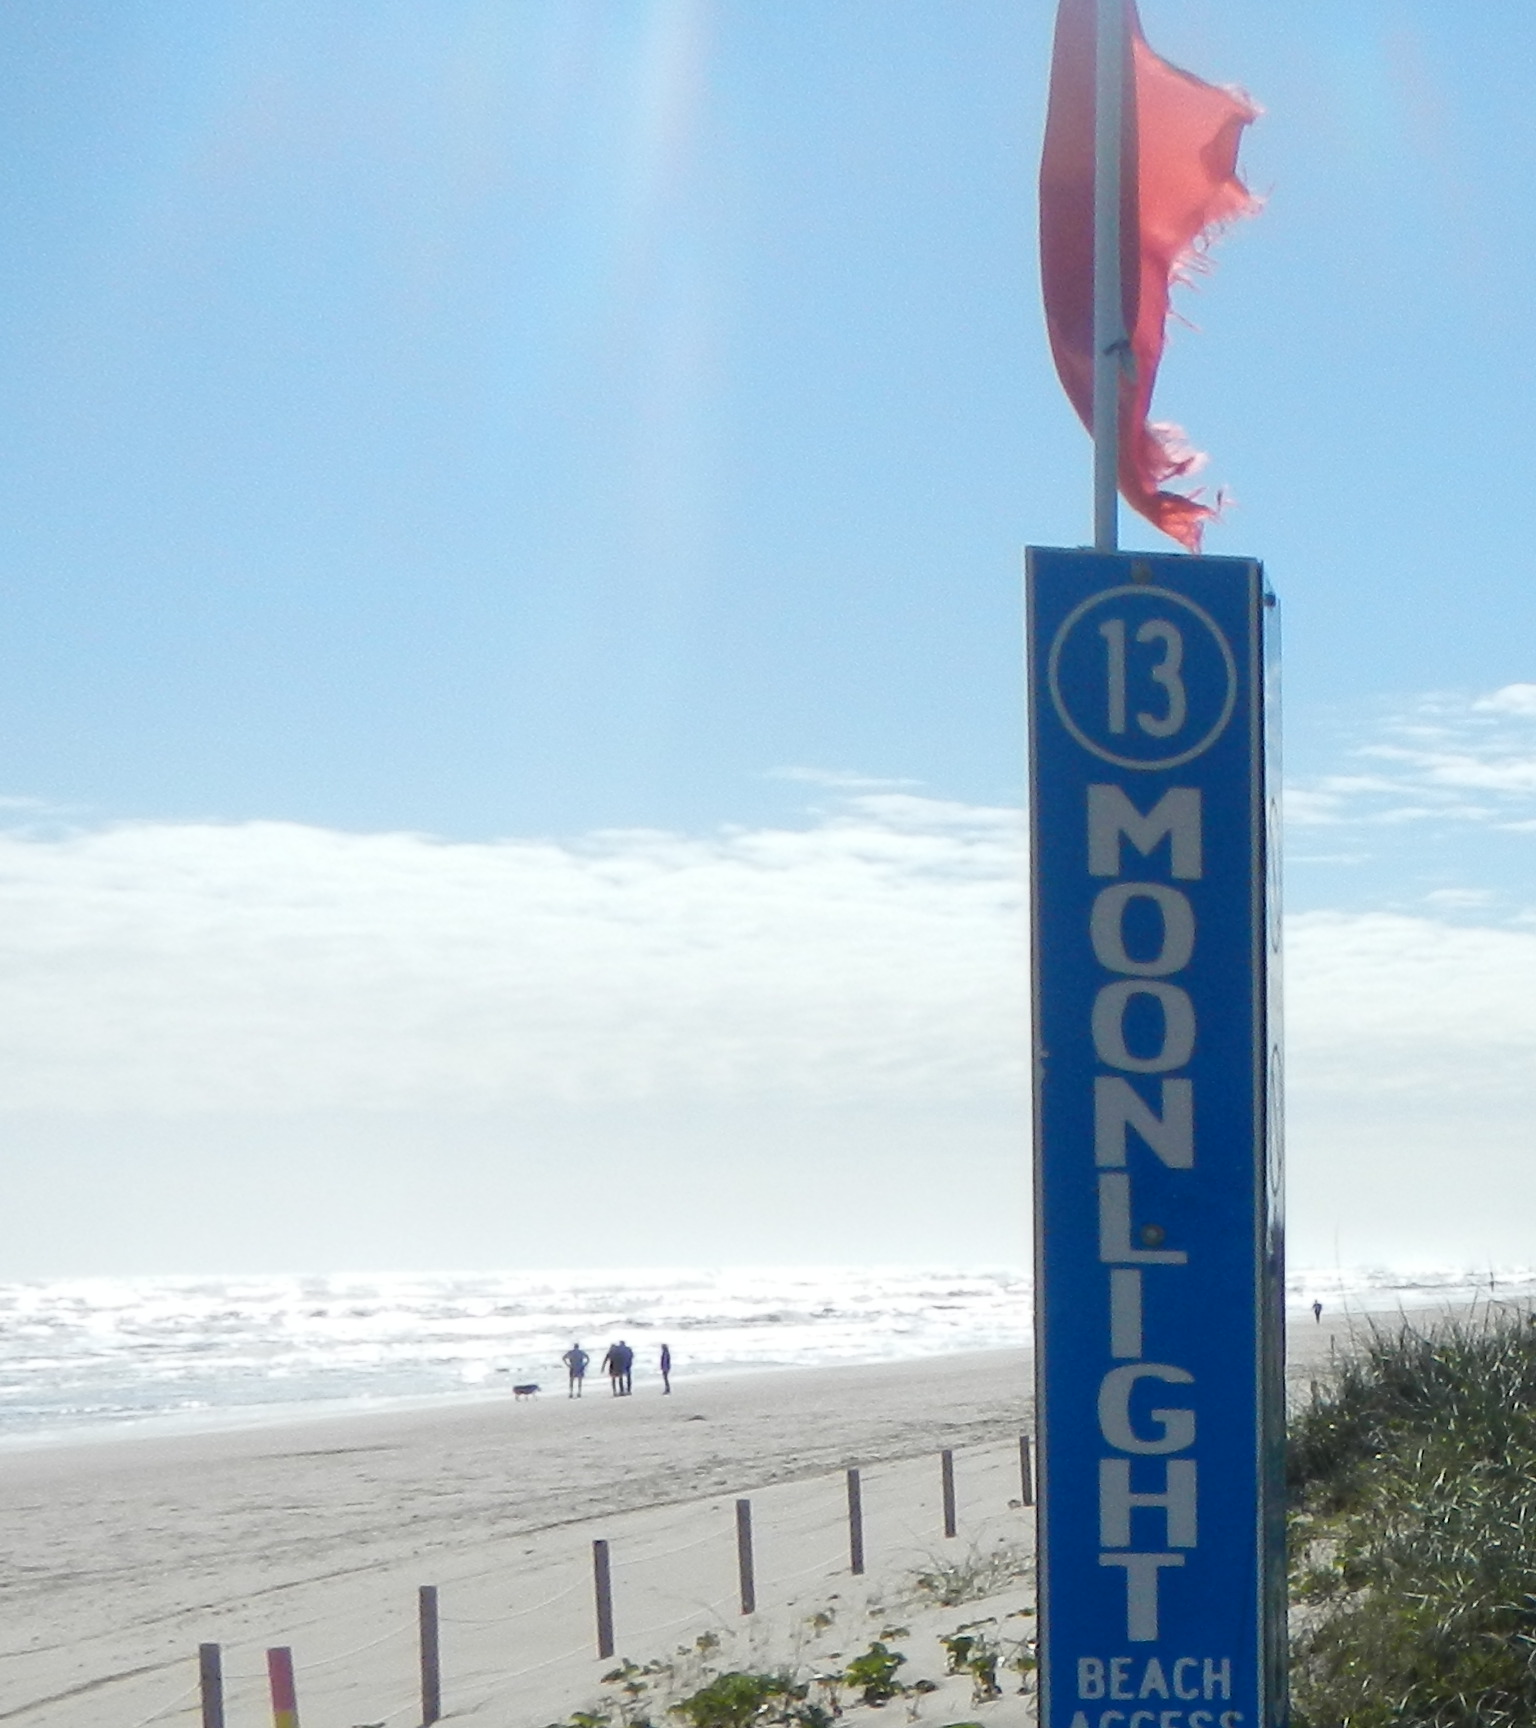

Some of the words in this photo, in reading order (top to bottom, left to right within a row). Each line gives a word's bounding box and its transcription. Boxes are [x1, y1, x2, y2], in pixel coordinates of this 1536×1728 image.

[1099, 618, 1187, 738] 13
[1087, 784, 1202, 1642] MOONLIGHT
[1078, 1657, 1231, 1700] BEACH
